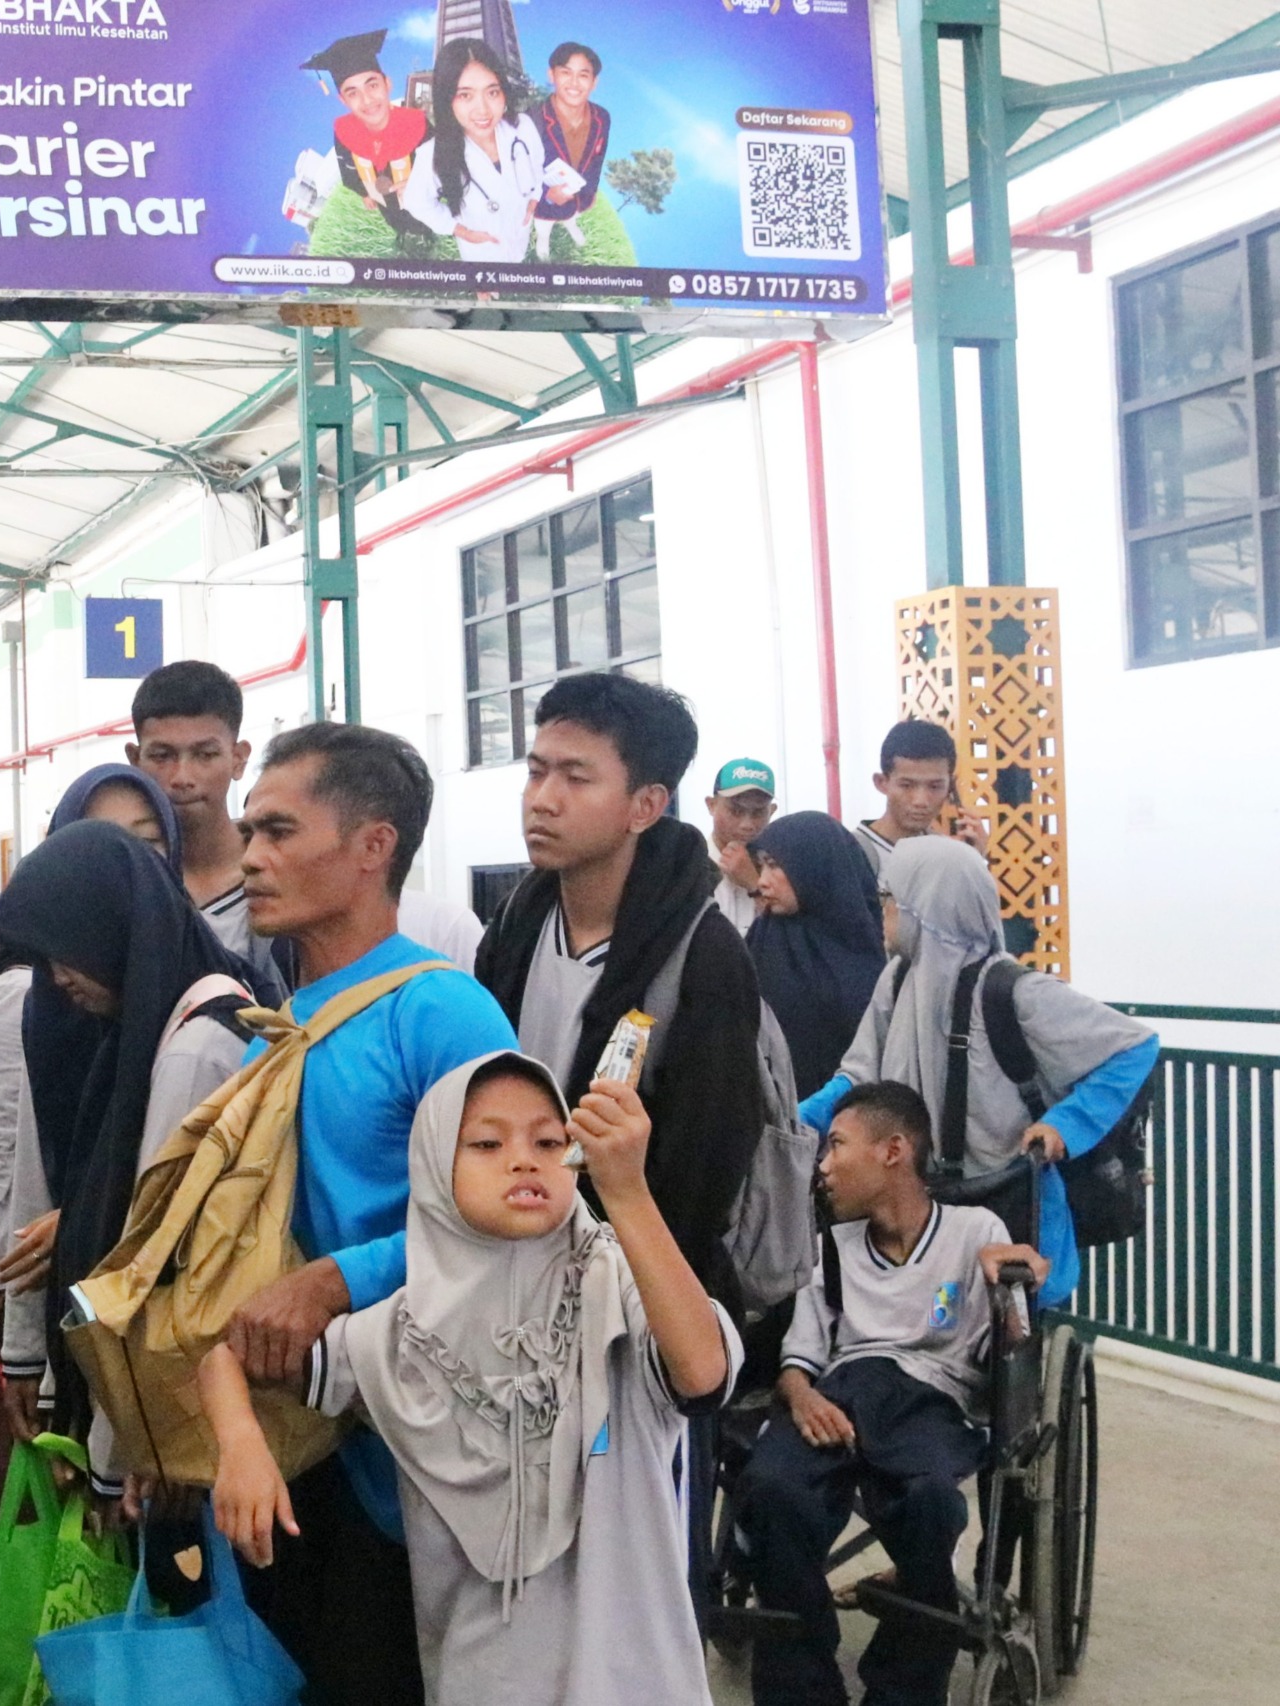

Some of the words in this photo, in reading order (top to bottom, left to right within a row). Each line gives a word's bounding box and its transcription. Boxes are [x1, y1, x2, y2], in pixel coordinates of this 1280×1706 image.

[55, 22, 86, 37] Ilmu
[91, 22, 169, 40] Kesehatan
[73, 75, 193, 107] Pintar
[742, 112, 784, 125] Daftar
[786, 114, 846, 129] Sekarang
[230, 264, 331, 278] www.iik.ac.id
[692, 275, 751, 296] 0857
[756, 277, 801, 298] 1717
[806, 278, 857, 300] 1735
[114, 616, 136, 659] 1
